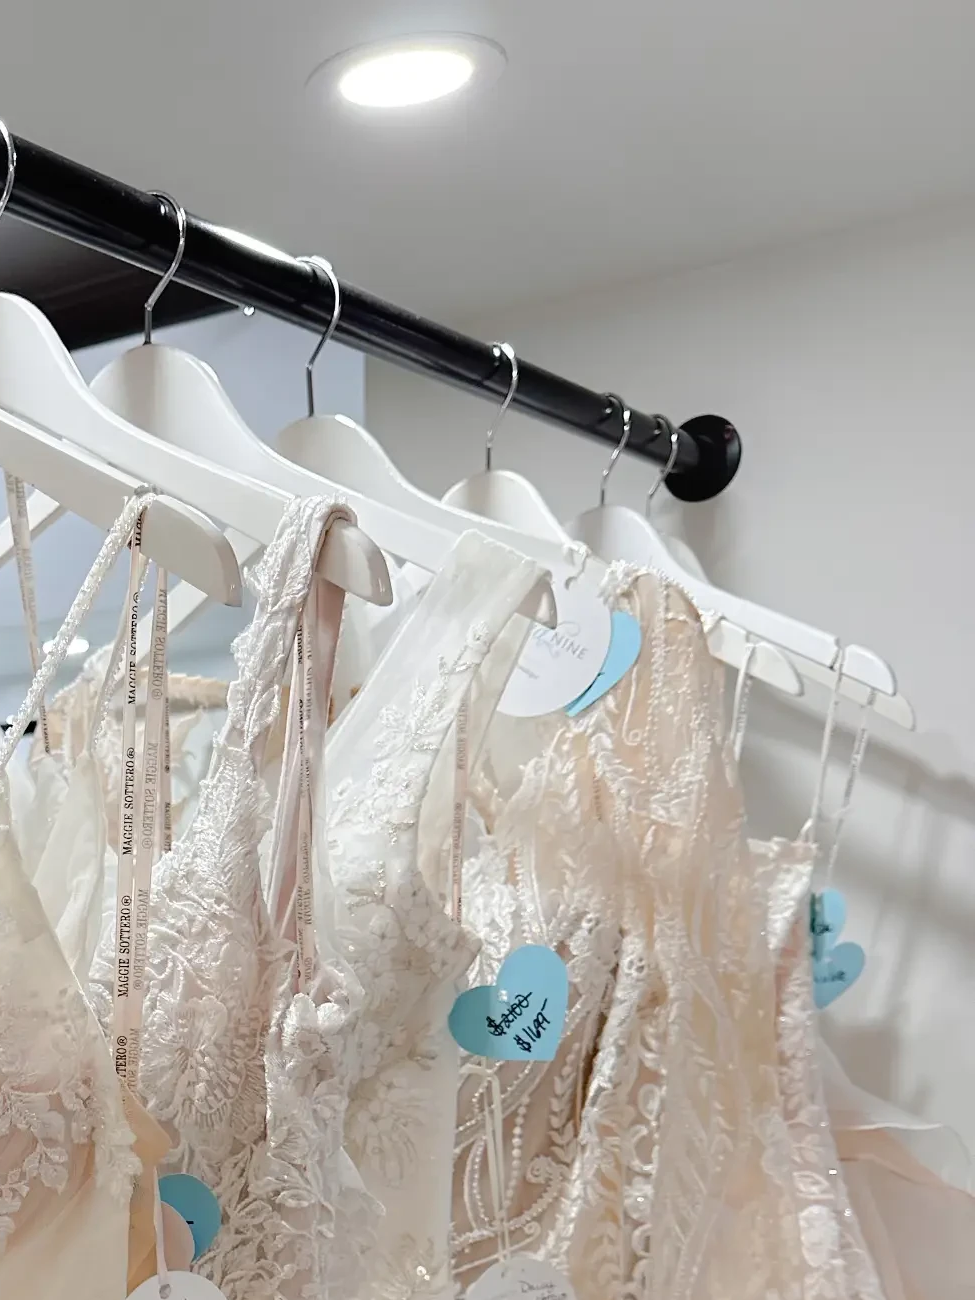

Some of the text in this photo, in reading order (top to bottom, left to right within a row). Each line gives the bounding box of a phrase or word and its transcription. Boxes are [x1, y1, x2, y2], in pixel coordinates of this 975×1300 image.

[122, 747, 135, 856] MAGGIE SOTTERO®
[117, 894, 133, 998] MAGGIE SOTTERO®
